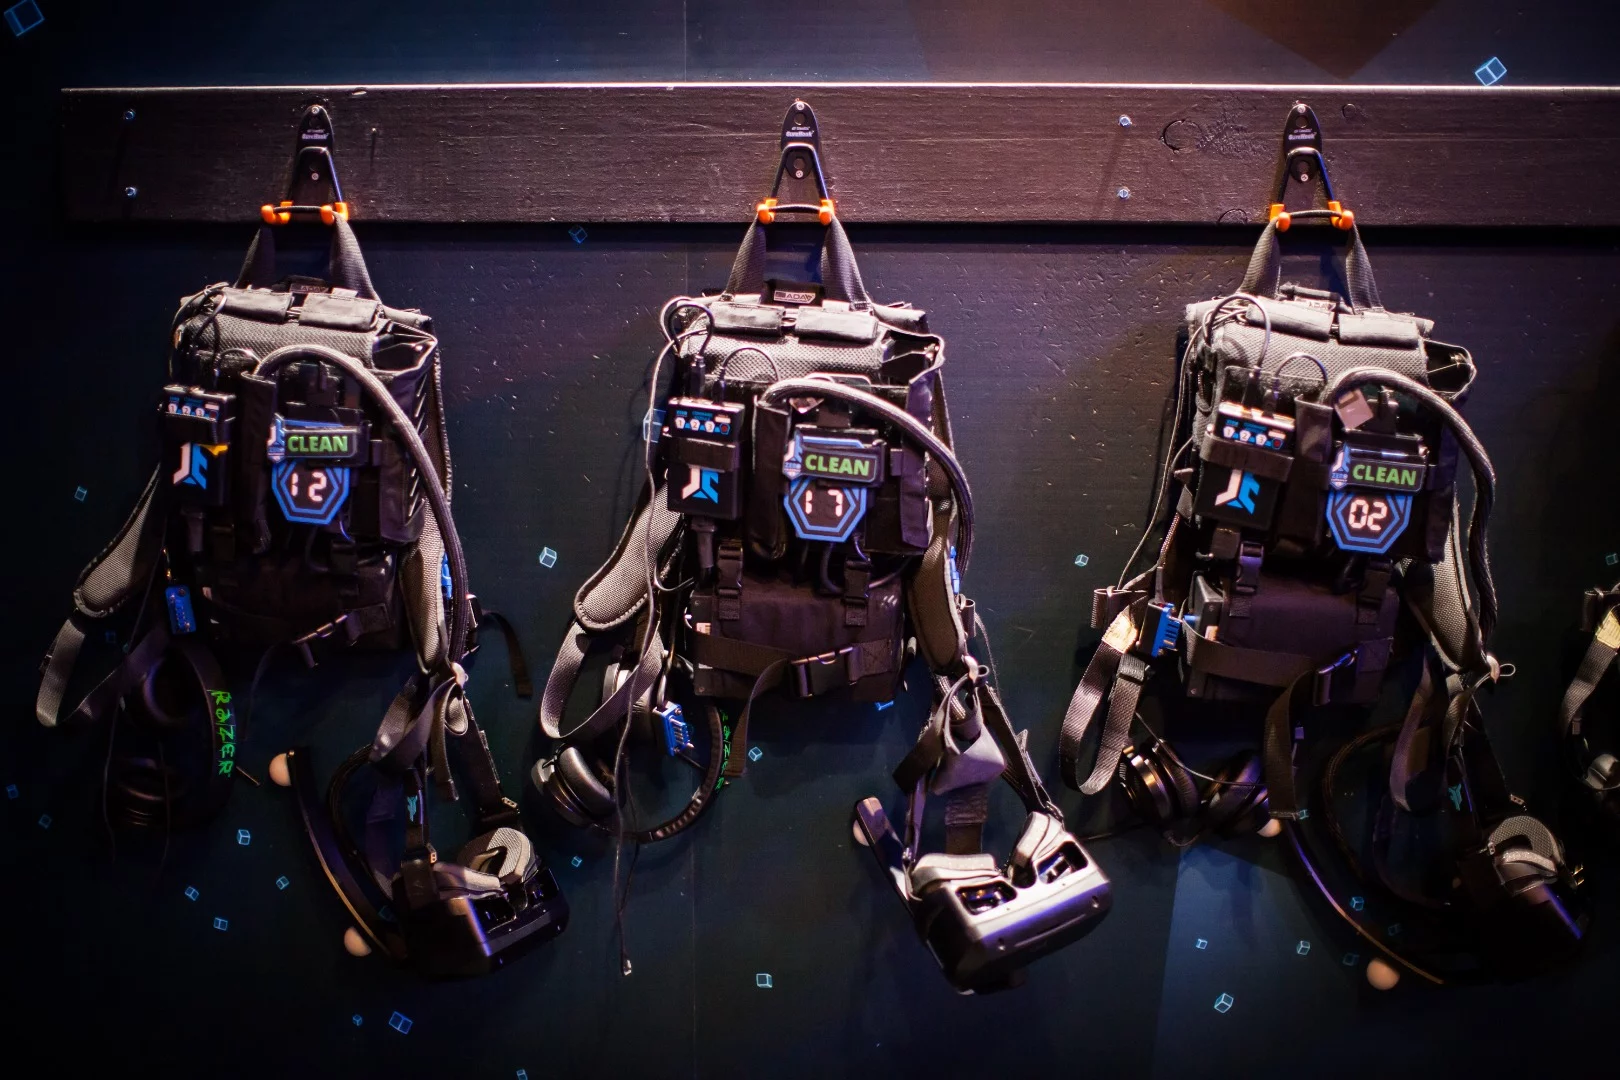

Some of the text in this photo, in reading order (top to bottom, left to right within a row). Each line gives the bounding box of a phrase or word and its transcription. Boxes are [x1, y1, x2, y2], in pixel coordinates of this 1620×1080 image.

[287, 435, 349, 453] CLEAN
[805, 454, 870, 477] CLEAN
[1352, 464, 1417, 486] CLEAN
[291, 471, 327, 502] 12
[805, 489, 843, 517] 17
[1348, 499, 1388, 531] 02
